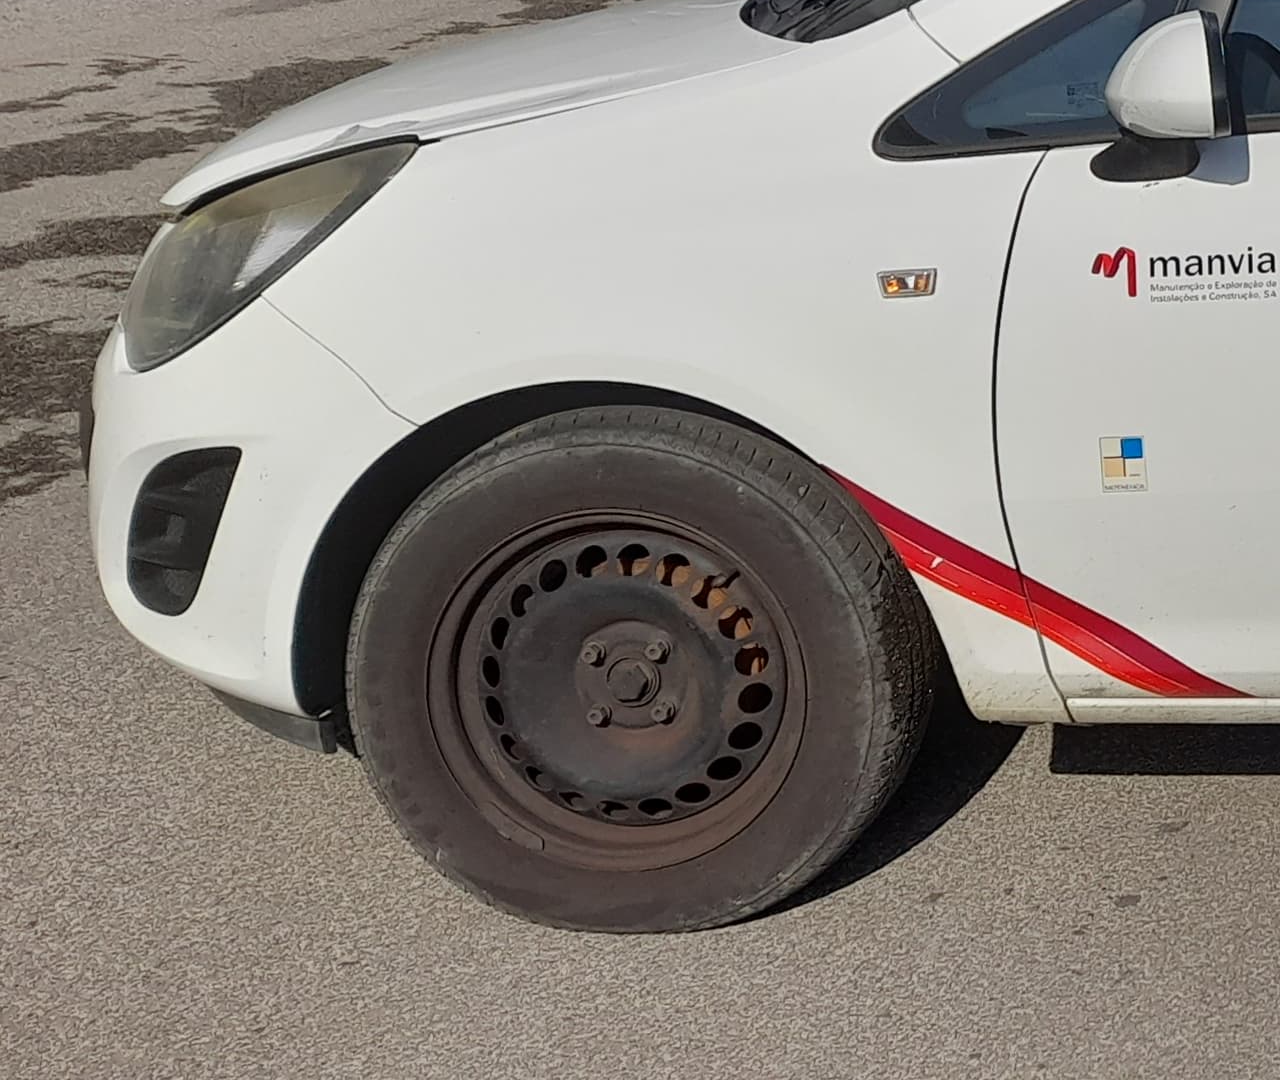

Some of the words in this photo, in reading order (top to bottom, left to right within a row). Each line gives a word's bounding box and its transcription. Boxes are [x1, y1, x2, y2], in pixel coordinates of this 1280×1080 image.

[1149, 246, 1277, 278] manvia
[1150, 282, 1205, 292] Manutenção
[1214, 280, 1264, 291] Exploração
